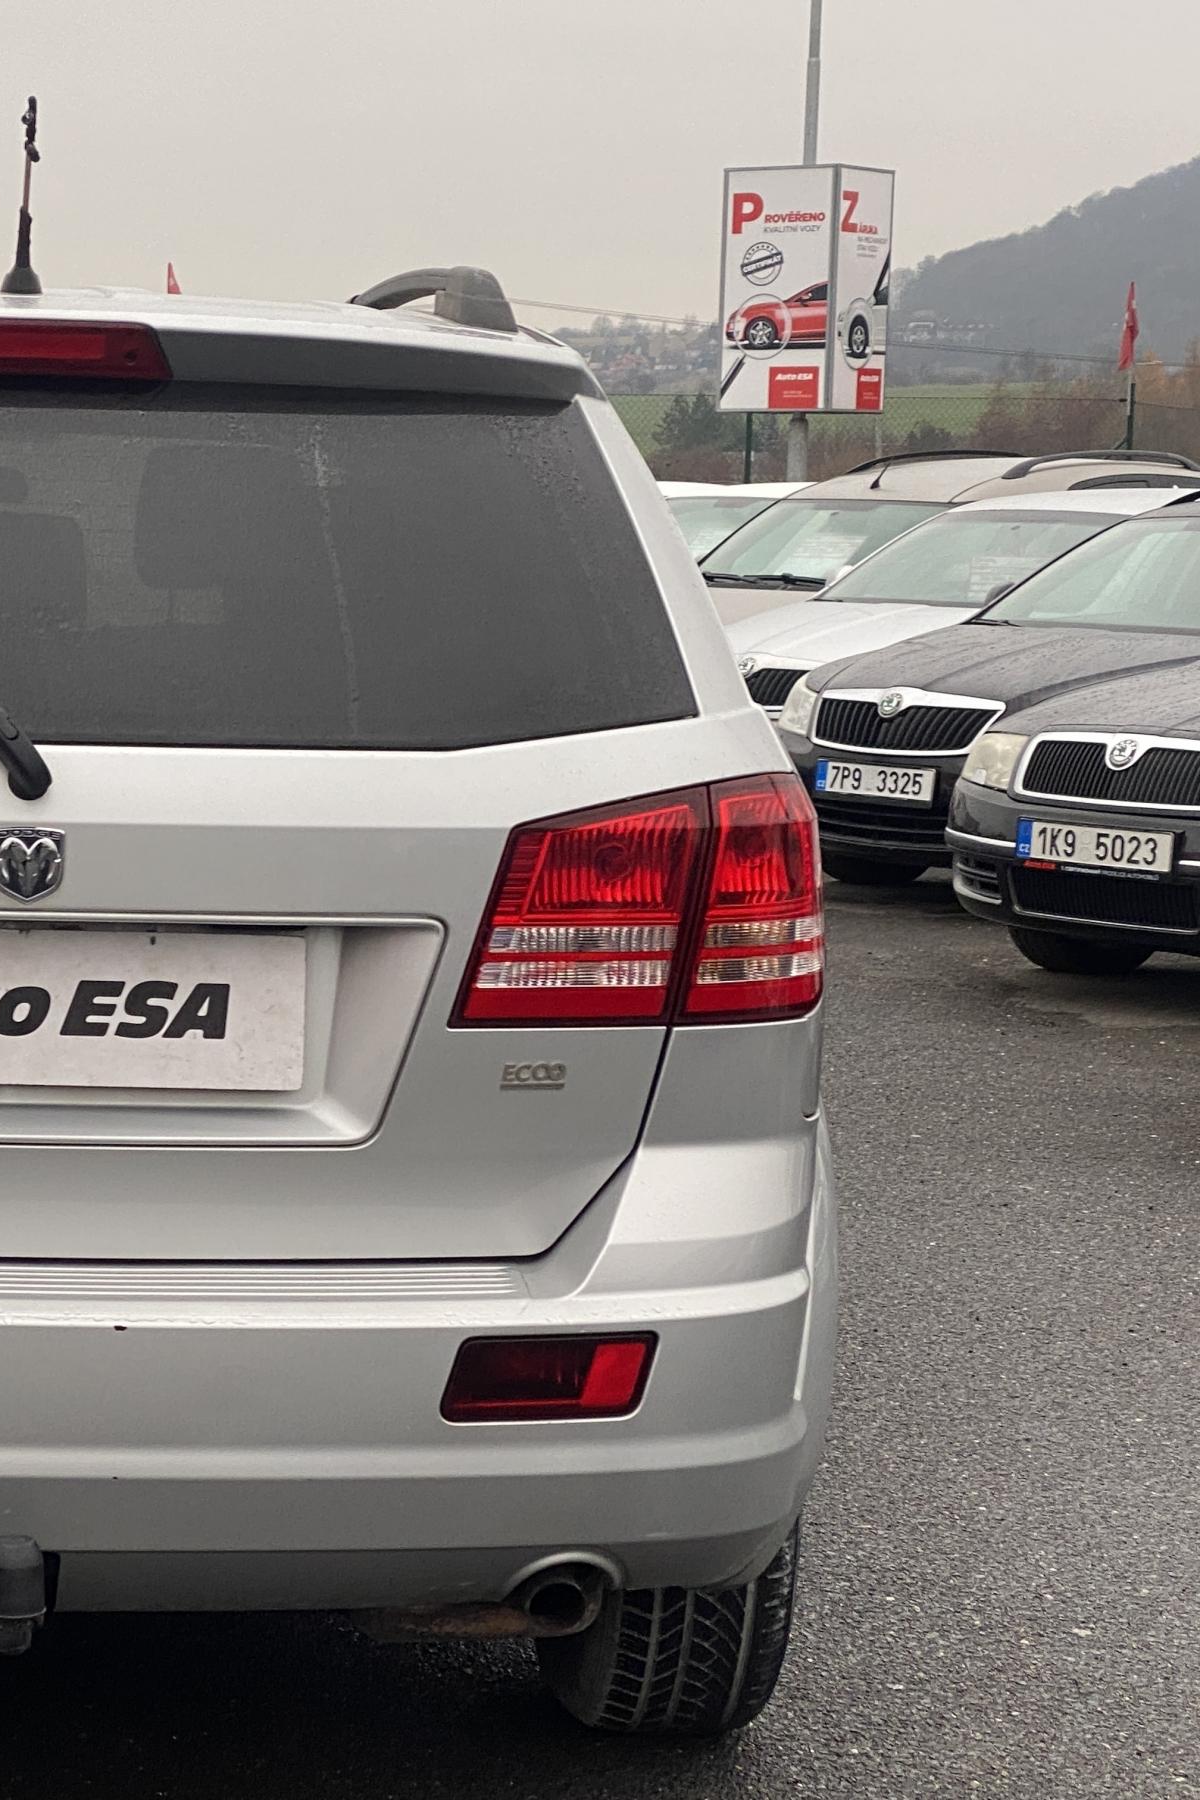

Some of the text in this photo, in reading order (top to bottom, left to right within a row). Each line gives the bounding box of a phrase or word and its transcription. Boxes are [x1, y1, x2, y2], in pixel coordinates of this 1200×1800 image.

[829, 765, 924, 795] 7P9 3325
[1019, 843, 1030, 852] CZ
[1038, 827, 1158, 865] 1K9 5023
[59, 979, 231, 1040] ESA
